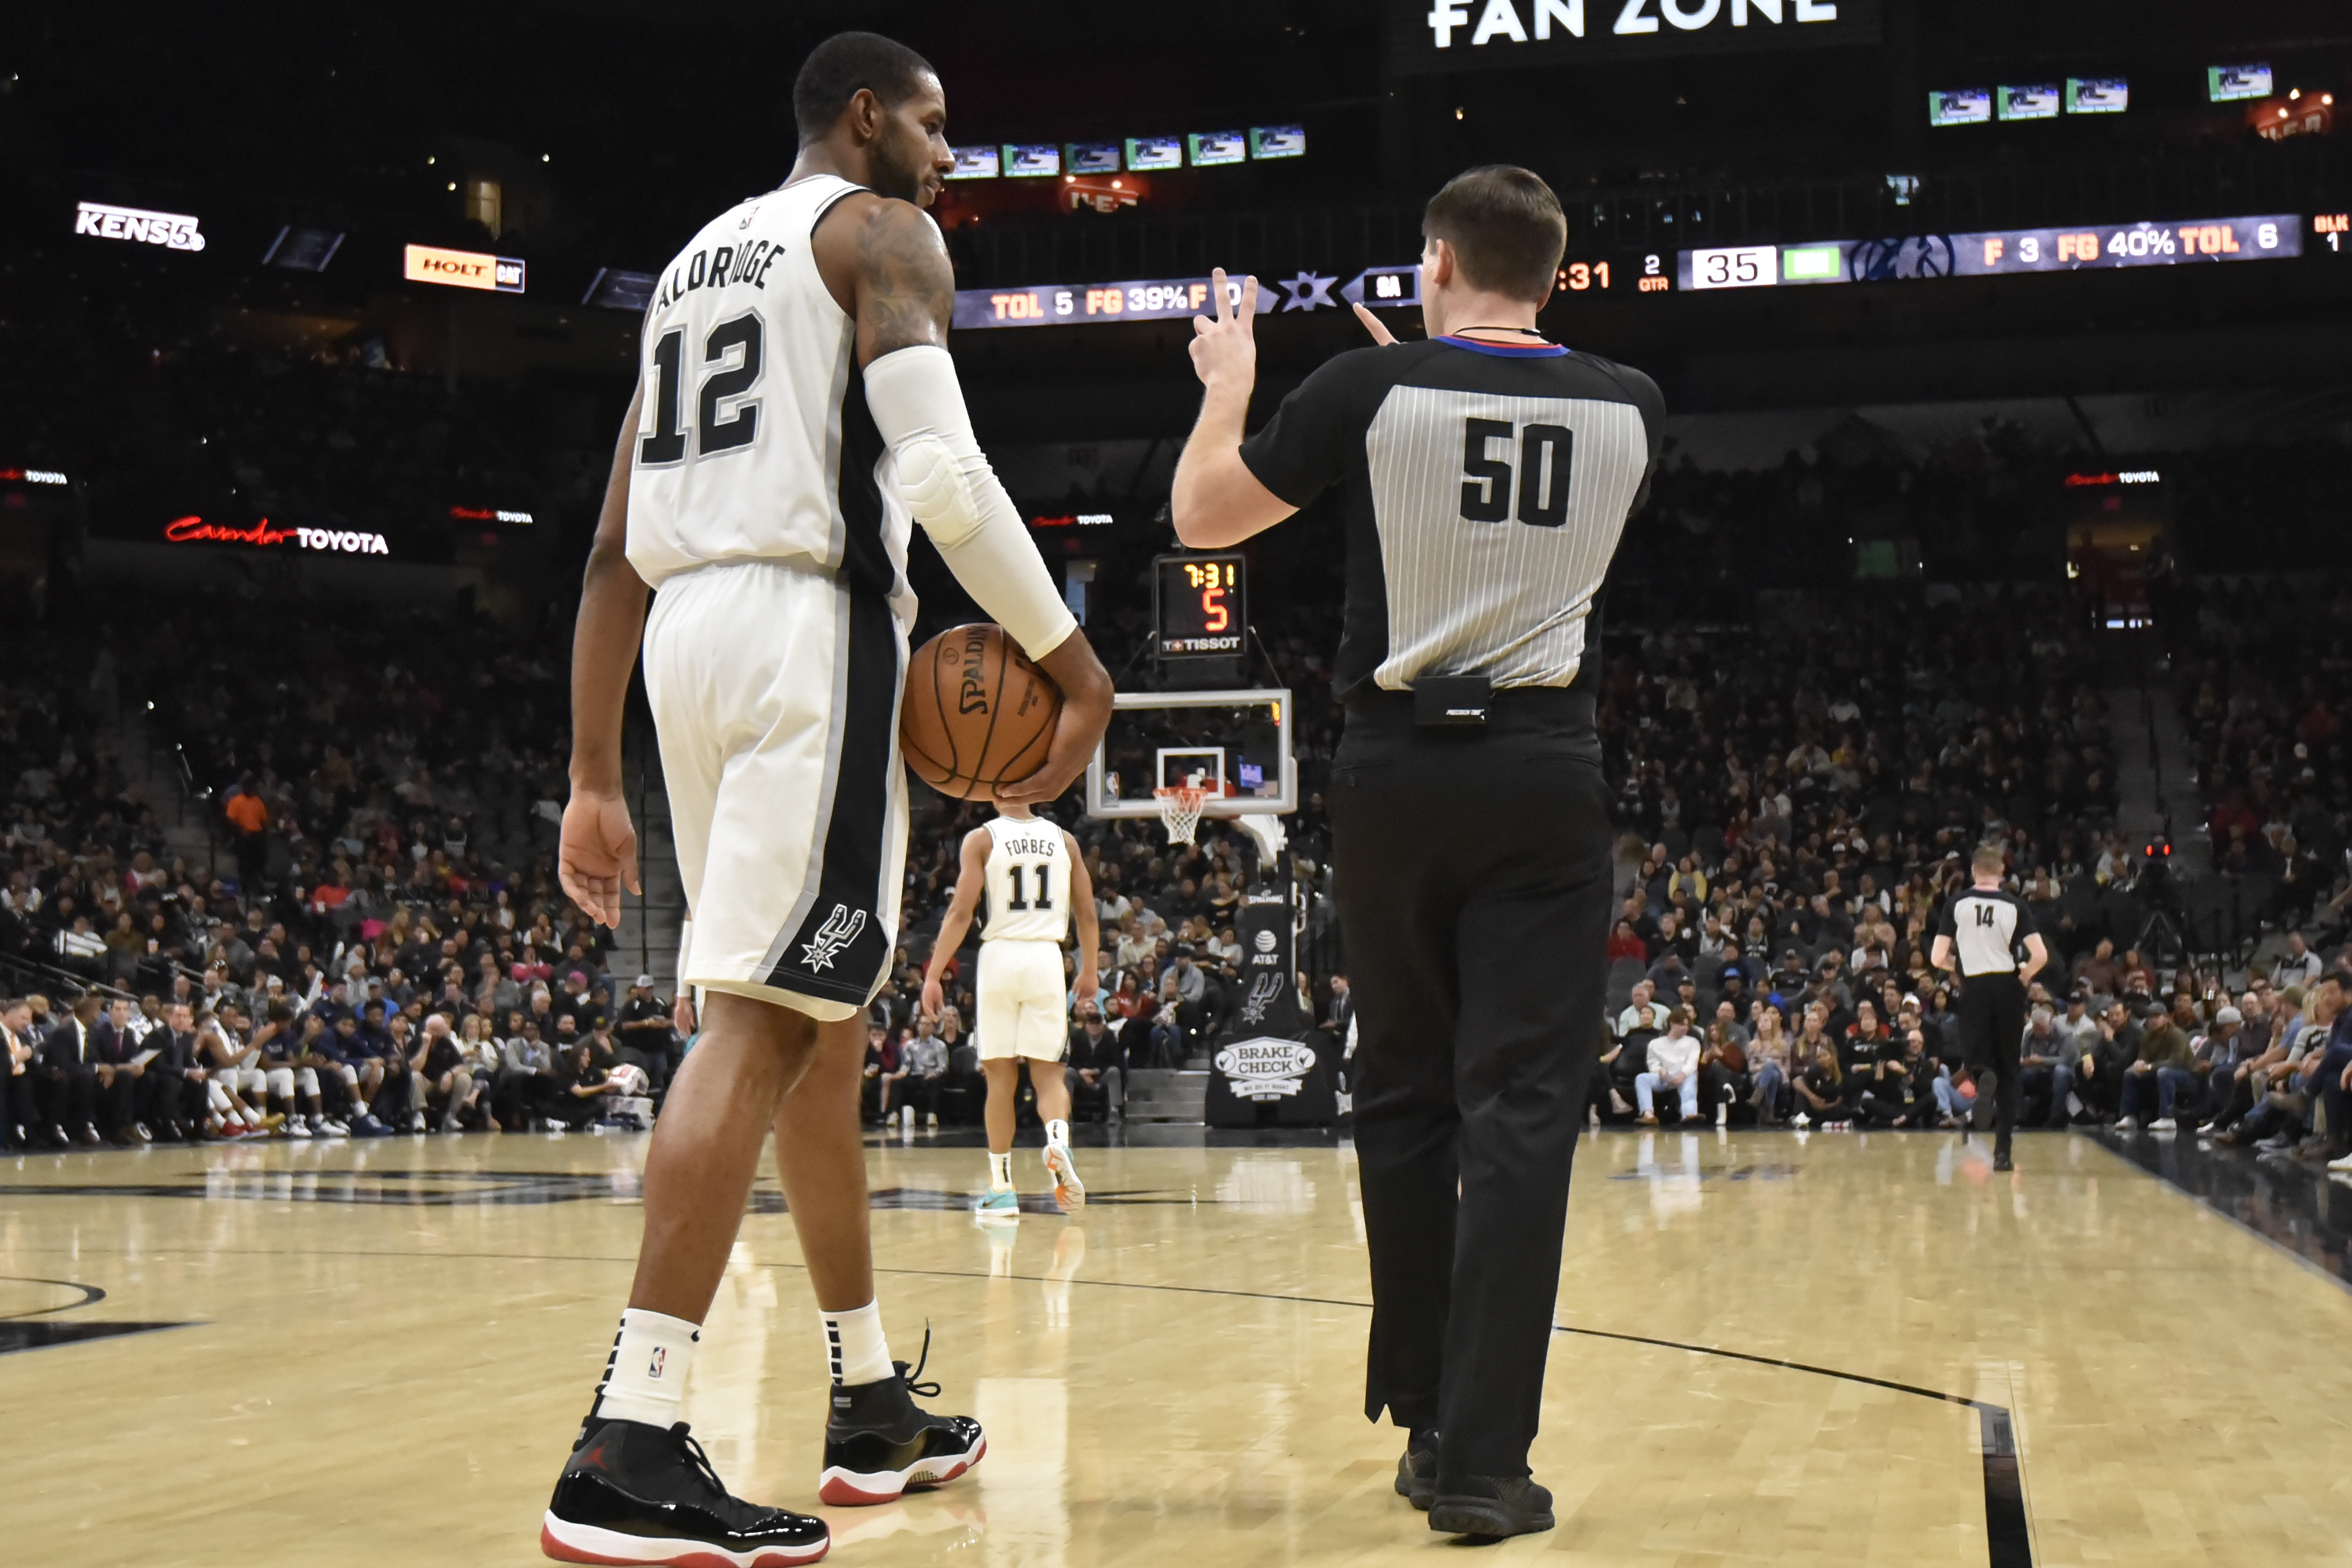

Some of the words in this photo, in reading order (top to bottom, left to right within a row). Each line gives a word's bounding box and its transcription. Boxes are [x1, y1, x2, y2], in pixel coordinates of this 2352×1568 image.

[1427, 0, 1585, 48] FAN
[2313, 214, 2349, 232] BLK
[1984, 239, 2003, 267] F
[2019, 237, 2039, 262] 3
[2057, 232, 2099, 262] FG
[2107, 230, 2175, 258] 40%
[2178, 225, 2241, 255] TOL
[2258, 223, 2278, 248] 6
[2327, 231, 2338, 251] 1
[423, 258, 488, 278] HOLT
[497, 264, 521, 284] CAT
[1644, 254, 1660, 274] 2
[1706, 253, 1758, 284] 35
[656, 239, 786, 316] ALDRIDGE
[1638, 277, 1669, 293] QTR
[991, 293, 1044, 320] TOL
[1055, 291, 1074, 315] 5
[1085, 288, 1123, 315] FG
[1128, 286, 1188, 312] 39%
[1188, 283, 1207, 310] F
[636, 306, 766, 469] 12
[25, 469, 67, 485] TOYOTA
[1459, 417, 1573, 528] 50
[2118, 471, 2160, 484] TOYOTA
[496, 510, 533, 524] TOYOTA
[1076, 514, 1113, 525] TOYOTA
[296, 526, 389, 555] TOYOTA
[1183, 563, 1234, 589] 7:31
[1202, 587, 1228, 632] 5
[1183, 636, 1240, 651] TISSOT
[959, 627, 990, 715] SPALDIN
[1005, 838, 1056, 857] FORBES
[1007, 862, 1054, 913] 11
[1974, 903, 1995, 928] 14
[1252, 954, 1280, 965] AT&T
[1238, 1046, 1293, 1060] BRAKE
[1238, 1061, 1292, 1074] CHECK
